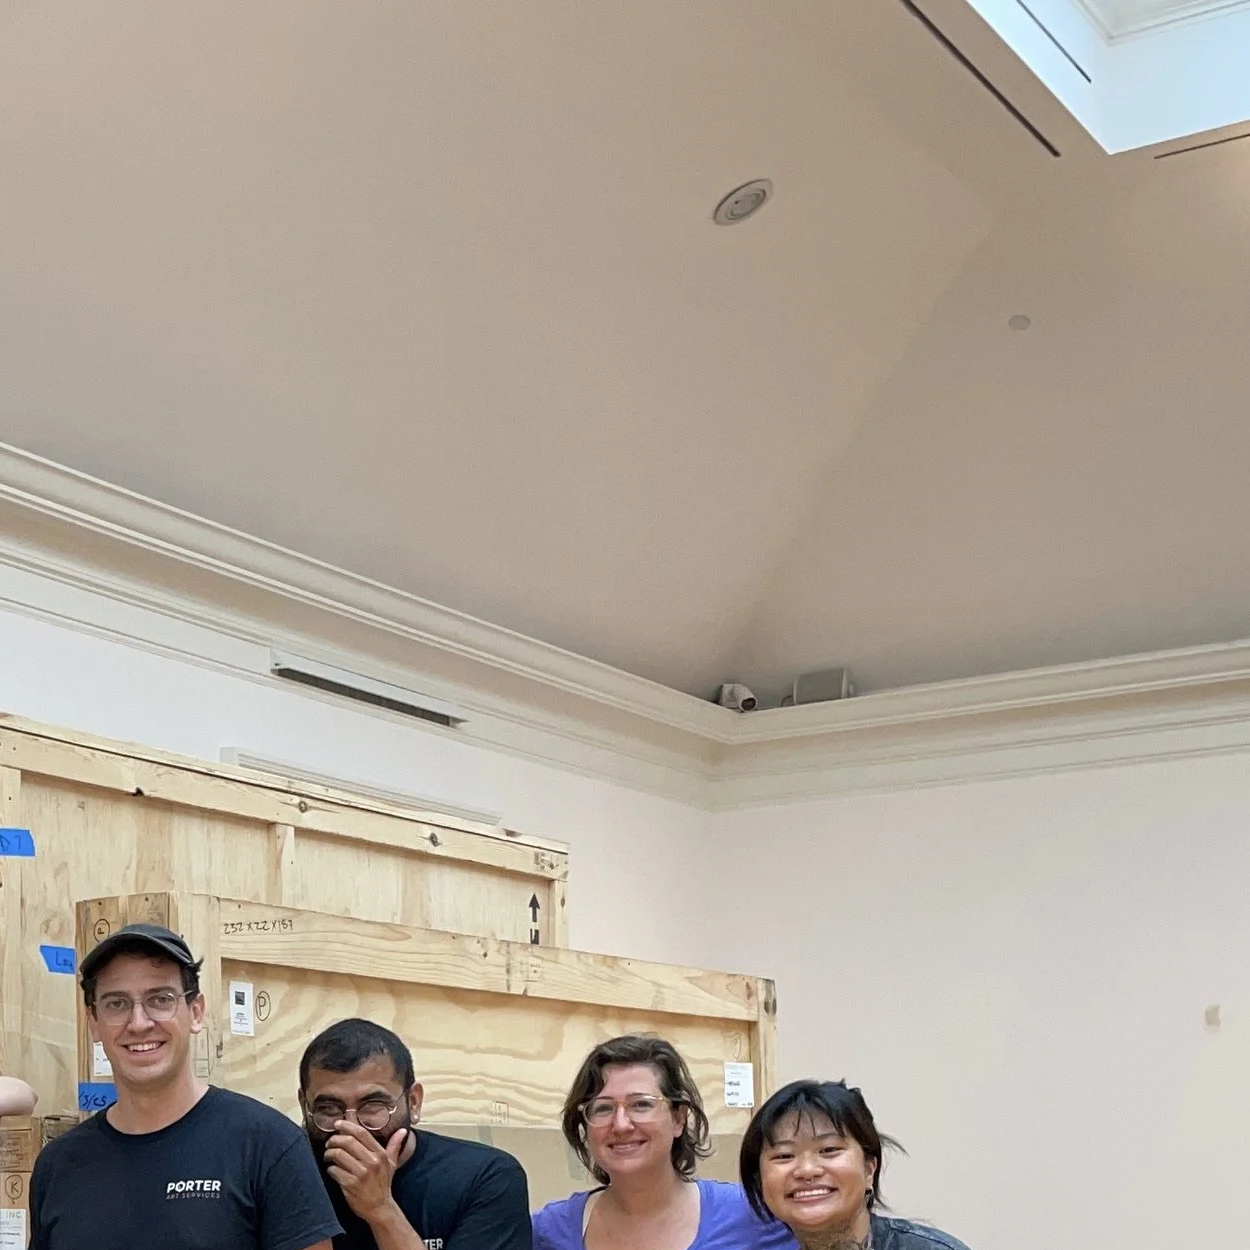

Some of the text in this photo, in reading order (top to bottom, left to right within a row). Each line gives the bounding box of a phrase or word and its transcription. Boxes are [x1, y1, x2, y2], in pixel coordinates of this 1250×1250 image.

[258, 996, 267, 1017] P
[10, 1181, 20, 1194] K
[166, 1180, 222, 1194] PORTER
[165, 1191, 221, 1200] ART SERVICES
[423, 1238, 444, 1250] TER
